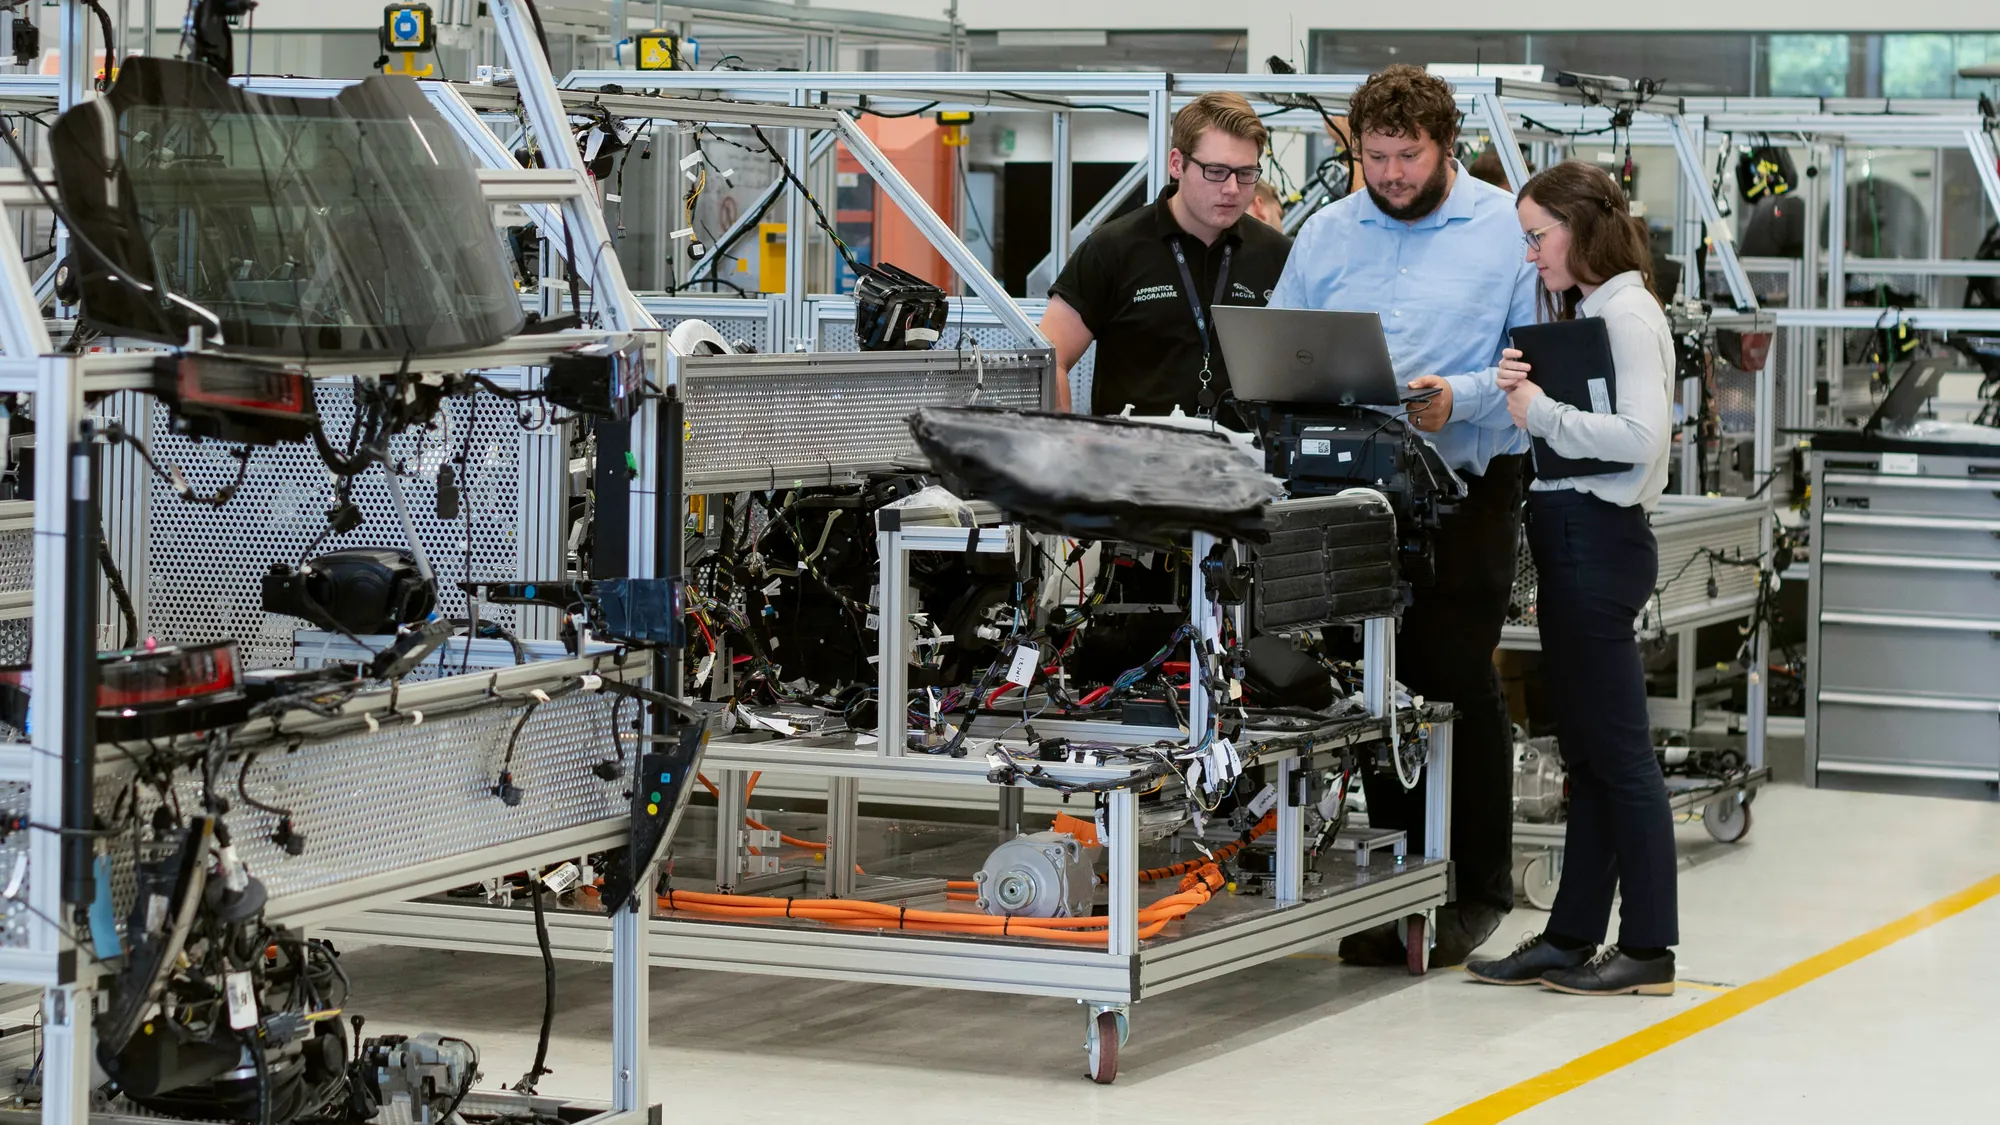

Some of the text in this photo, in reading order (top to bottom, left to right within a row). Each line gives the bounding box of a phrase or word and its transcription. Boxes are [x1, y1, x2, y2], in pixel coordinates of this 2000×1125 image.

[1136, 284, 1174, 296] APPRENTICE
[1231, 291, 1256, 299] JAGUAR
[1133, 291, 1178, 303] PROGRAMME
